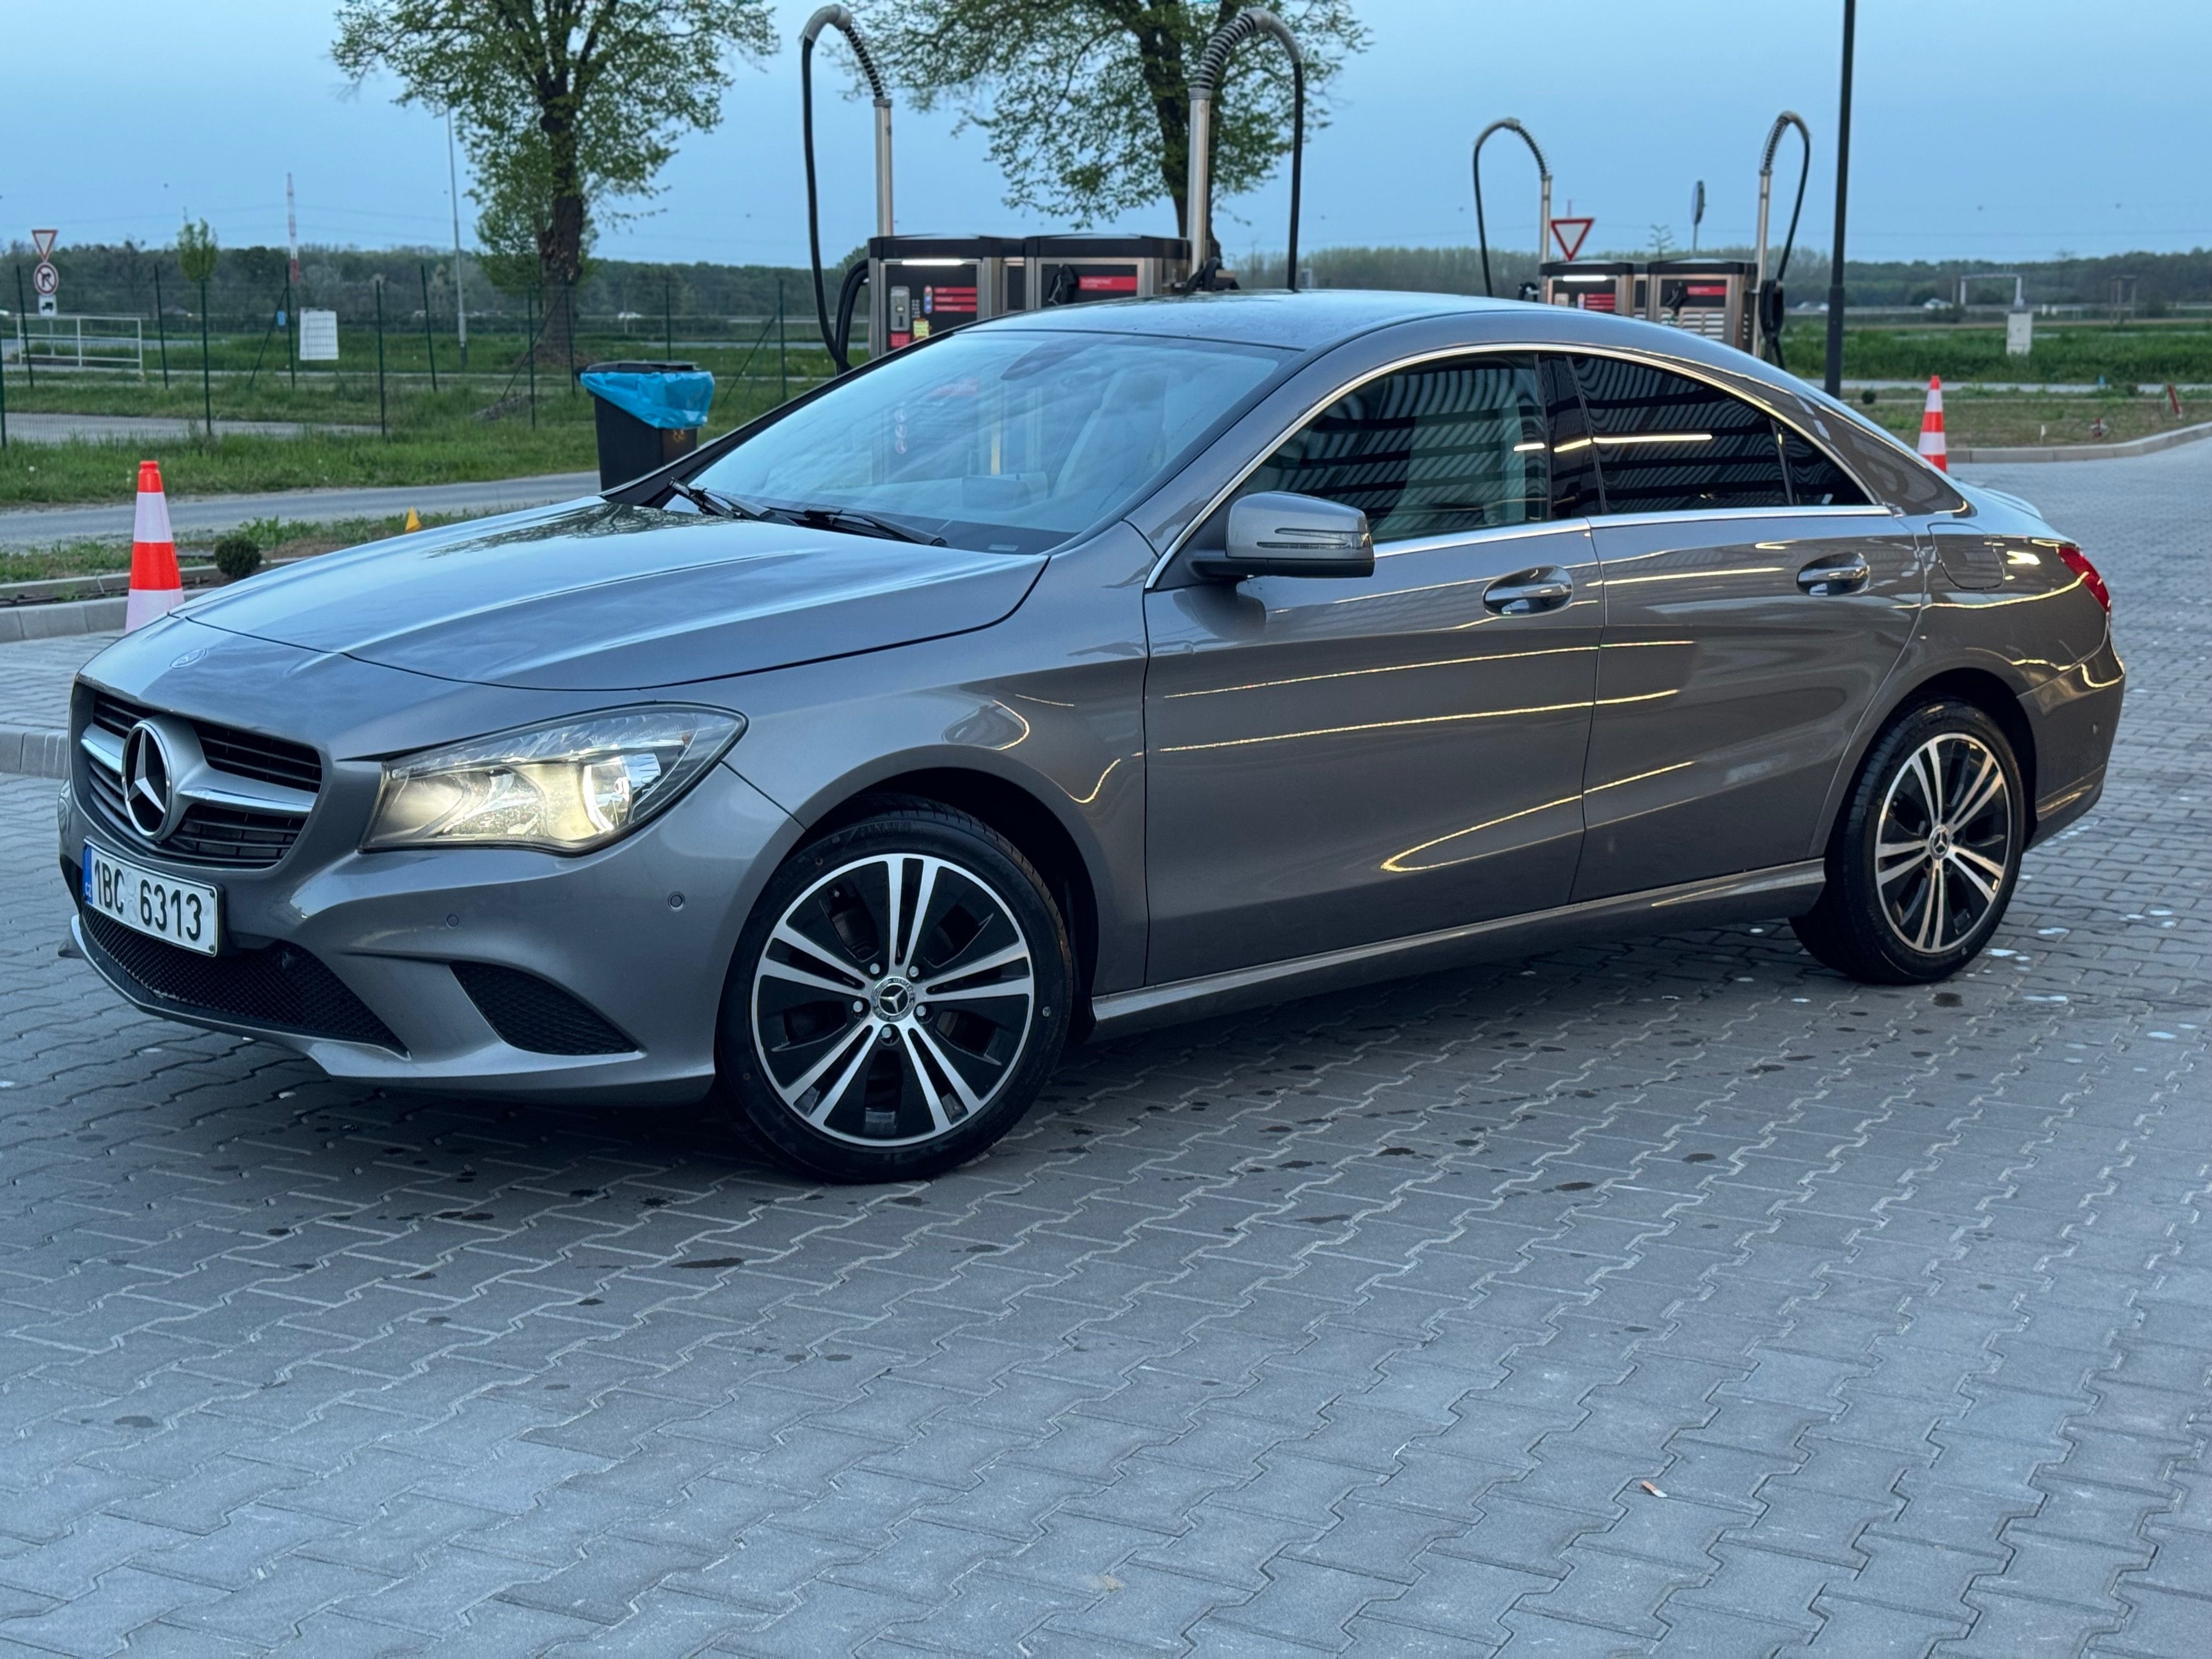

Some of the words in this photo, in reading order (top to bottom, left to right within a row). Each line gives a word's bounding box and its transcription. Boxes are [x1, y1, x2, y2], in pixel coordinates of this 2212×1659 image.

[85, 882, 92, 898] CZ
[94, 859, 125, 915] 1BC
[140, 879, 202, 941] 6313
